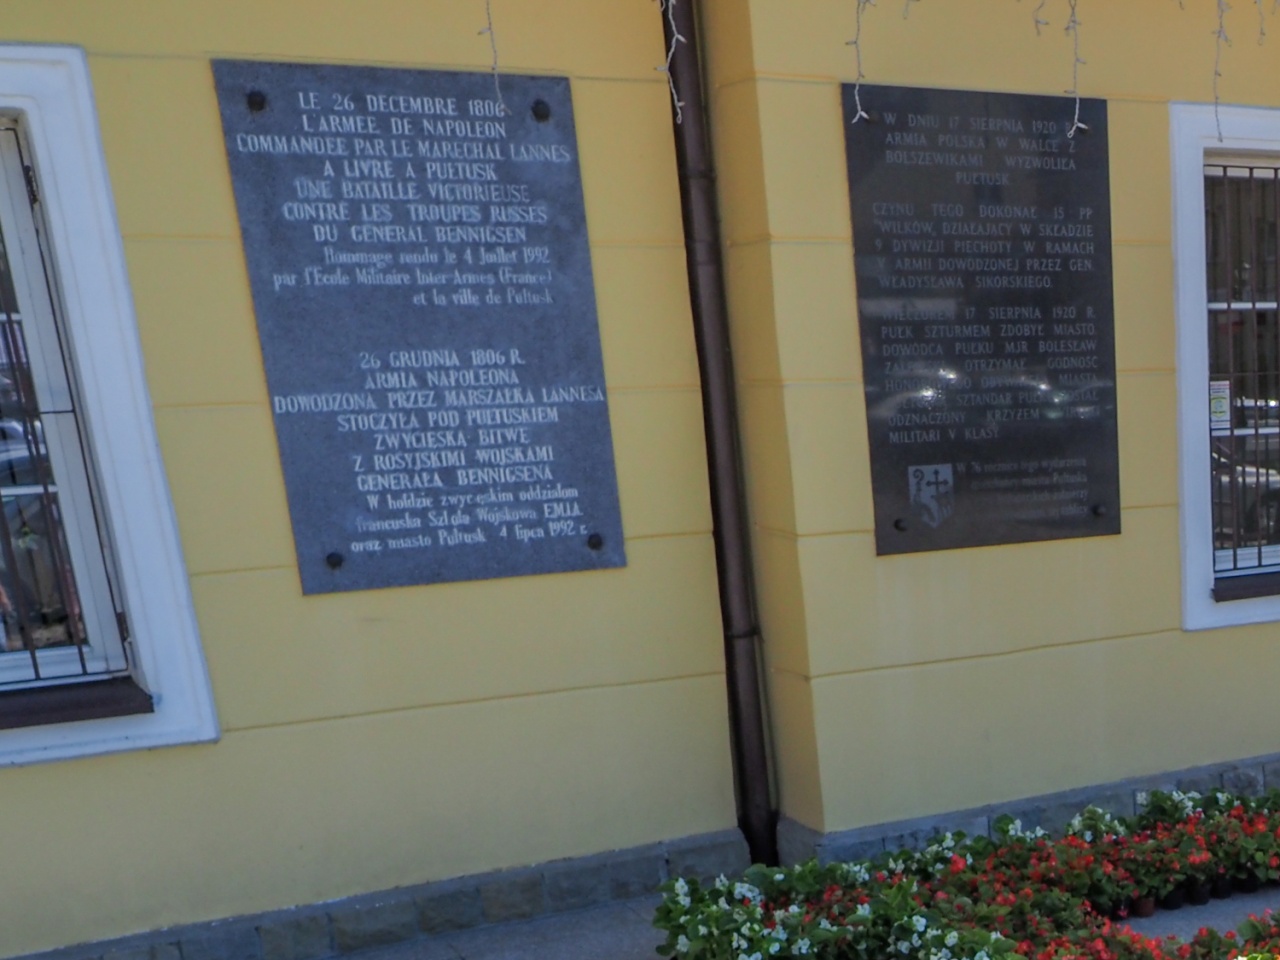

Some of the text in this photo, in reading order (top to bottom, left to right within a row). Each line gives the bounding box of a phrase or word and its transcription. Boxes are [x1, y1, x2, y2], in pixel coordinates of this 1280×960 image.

[299, 92, 505, 118] LE 26 DECEMBRE 1806
[302, 114, 507, 138] L'ARMEE DE NAPOLEON
[883, 111, 1057, 134] W DNIU 17 SIERPNIA 1920
[236, 133, 571, 162] COMMANDEE PAR LE MARECHAL LANNES
[885, 131, 1077, 153] ARMIA POLSKA W WALCE Z
[324, 160, 335, 177] A
[344, 159, 395, 178] LIVRE
[406, 162, 416, 178] A
[885, 149, 1077, 171] BOLSZEWIKAMI WYZWOLIŁA
[295, 177, 530, 202] UNE BATAILLE VICTORIEUSE
[282, 201, 548, 223] CONTRE LES TROUPES RUSSES
[872, 202, 1093, 220] CZYNU TEGO DOKONAŁ 15 PP
[313, 224, 527, 243] DU GENERAL BENNIGSEN
[1019, 223, 1032, 235] W
[1038, 223, 1094, 237] SKŁADZIE
[323, 246, 393, 268] Hommage
[401, 247, 438, 264] rendu
[445, 247, 457, 263] le
[463, 247, 472, 264] 4
[523, 246, 550, 263] 1992
[875, 238, 1095, 254] 9 DYWIZJI PIECHOTY W RAMACH
[895, 257, 932, 271] ARMII
[938, 257, 1019, 271] DOWODZONEJ
[1026, 258, 1062, 272] PRZEZ
[273, 273, 297, 291] par
[355, 267, 410, 285] Militaire
[499, 266, 552, 285] (France)
[879, 274, 965, 289] WŁADYSŁAWA
[413, 290, 427, 305] et
[433, 289, 447, 304] la
[452, 289, 479, 304] ville
[486, 289, 501, 304] de
[964, 305, 976, 320] 17
[988, 306, 1042, 320] SIERPNIA
[1052, 306, 1076, 319] 1920
[881, 325, 914, 339] PUŁK
[924, 324, 991, 339] SZTURMEM
[1000, 323, 1045, 337] ZDOBYŁ
[955, 341, 994, 355] PUŁKU
[1004, 341, 1029, 353] MJR
[1038, 339, 1097, 353] BOLESŁAW
[360, 352, 381, 369] 26
[389, 349, 460, 368] GRUDNIA
[471, 349, 506, 366] 1806
[365, 368, 519, 390] ARMIA NAPOLEONA
[274, 386, 604, 414] DOWODZONA PRZEZ MARSZAŁKA LANNESA
[337, 411, 420, 432] STOCZYŁA
[428, 410, 460, 427] POD
[888, 411, 967, 427] ODZNACZONY
[889, 429, 940, 444] MILITARI
[948, 428, 957, 440] V
[352, 446, 554, 472] Z ROSYJSKIMI WOJSKAMI
[357, 463, 553, 491] GENERAŁA BENNIGSENA
[367, 494, 379, 510] W
[355, 512, 422, 533] francuska
[476, 506, 537, 526] Wojskowa
[351, 539, 383, 552] oraz
[500, 525, 508, 538] 4
[515, 524, 545, 542] lipca
[549, 519, 576, 537] 1992
